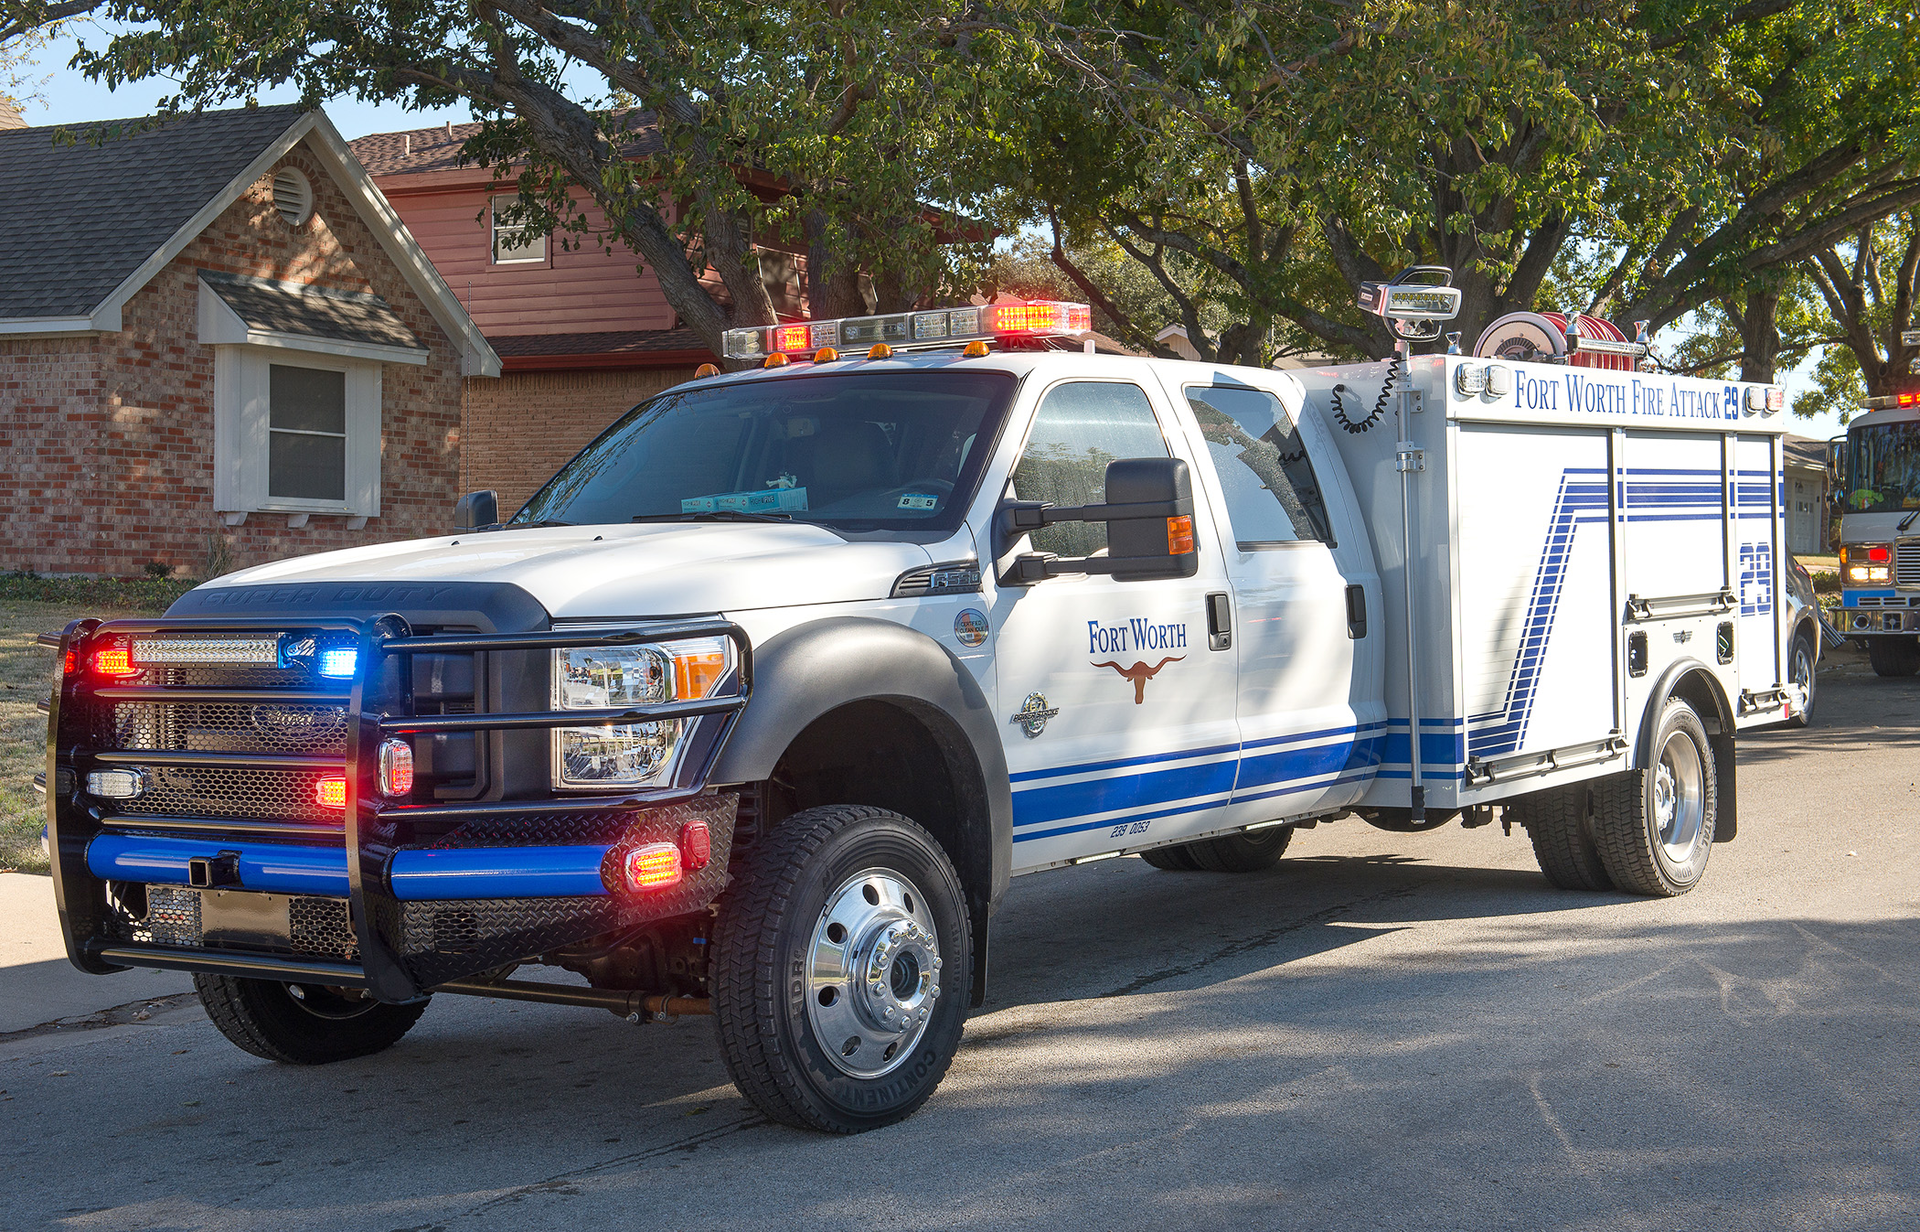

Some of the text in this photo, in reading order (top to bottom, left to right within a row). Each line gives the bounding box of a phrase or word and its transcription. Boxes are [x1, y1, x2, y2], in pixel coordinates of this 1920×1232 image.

[1515, 370, 1739, 420] FORT WORTH FIRE ATTACK 29
[202, 586, 452, 606] SUPER DUTY
[1740, 542, 1771, 617] 29
[1087, 618, 1187, 653] FORT WORTH
[1110, 824, 1128, 838] 239
